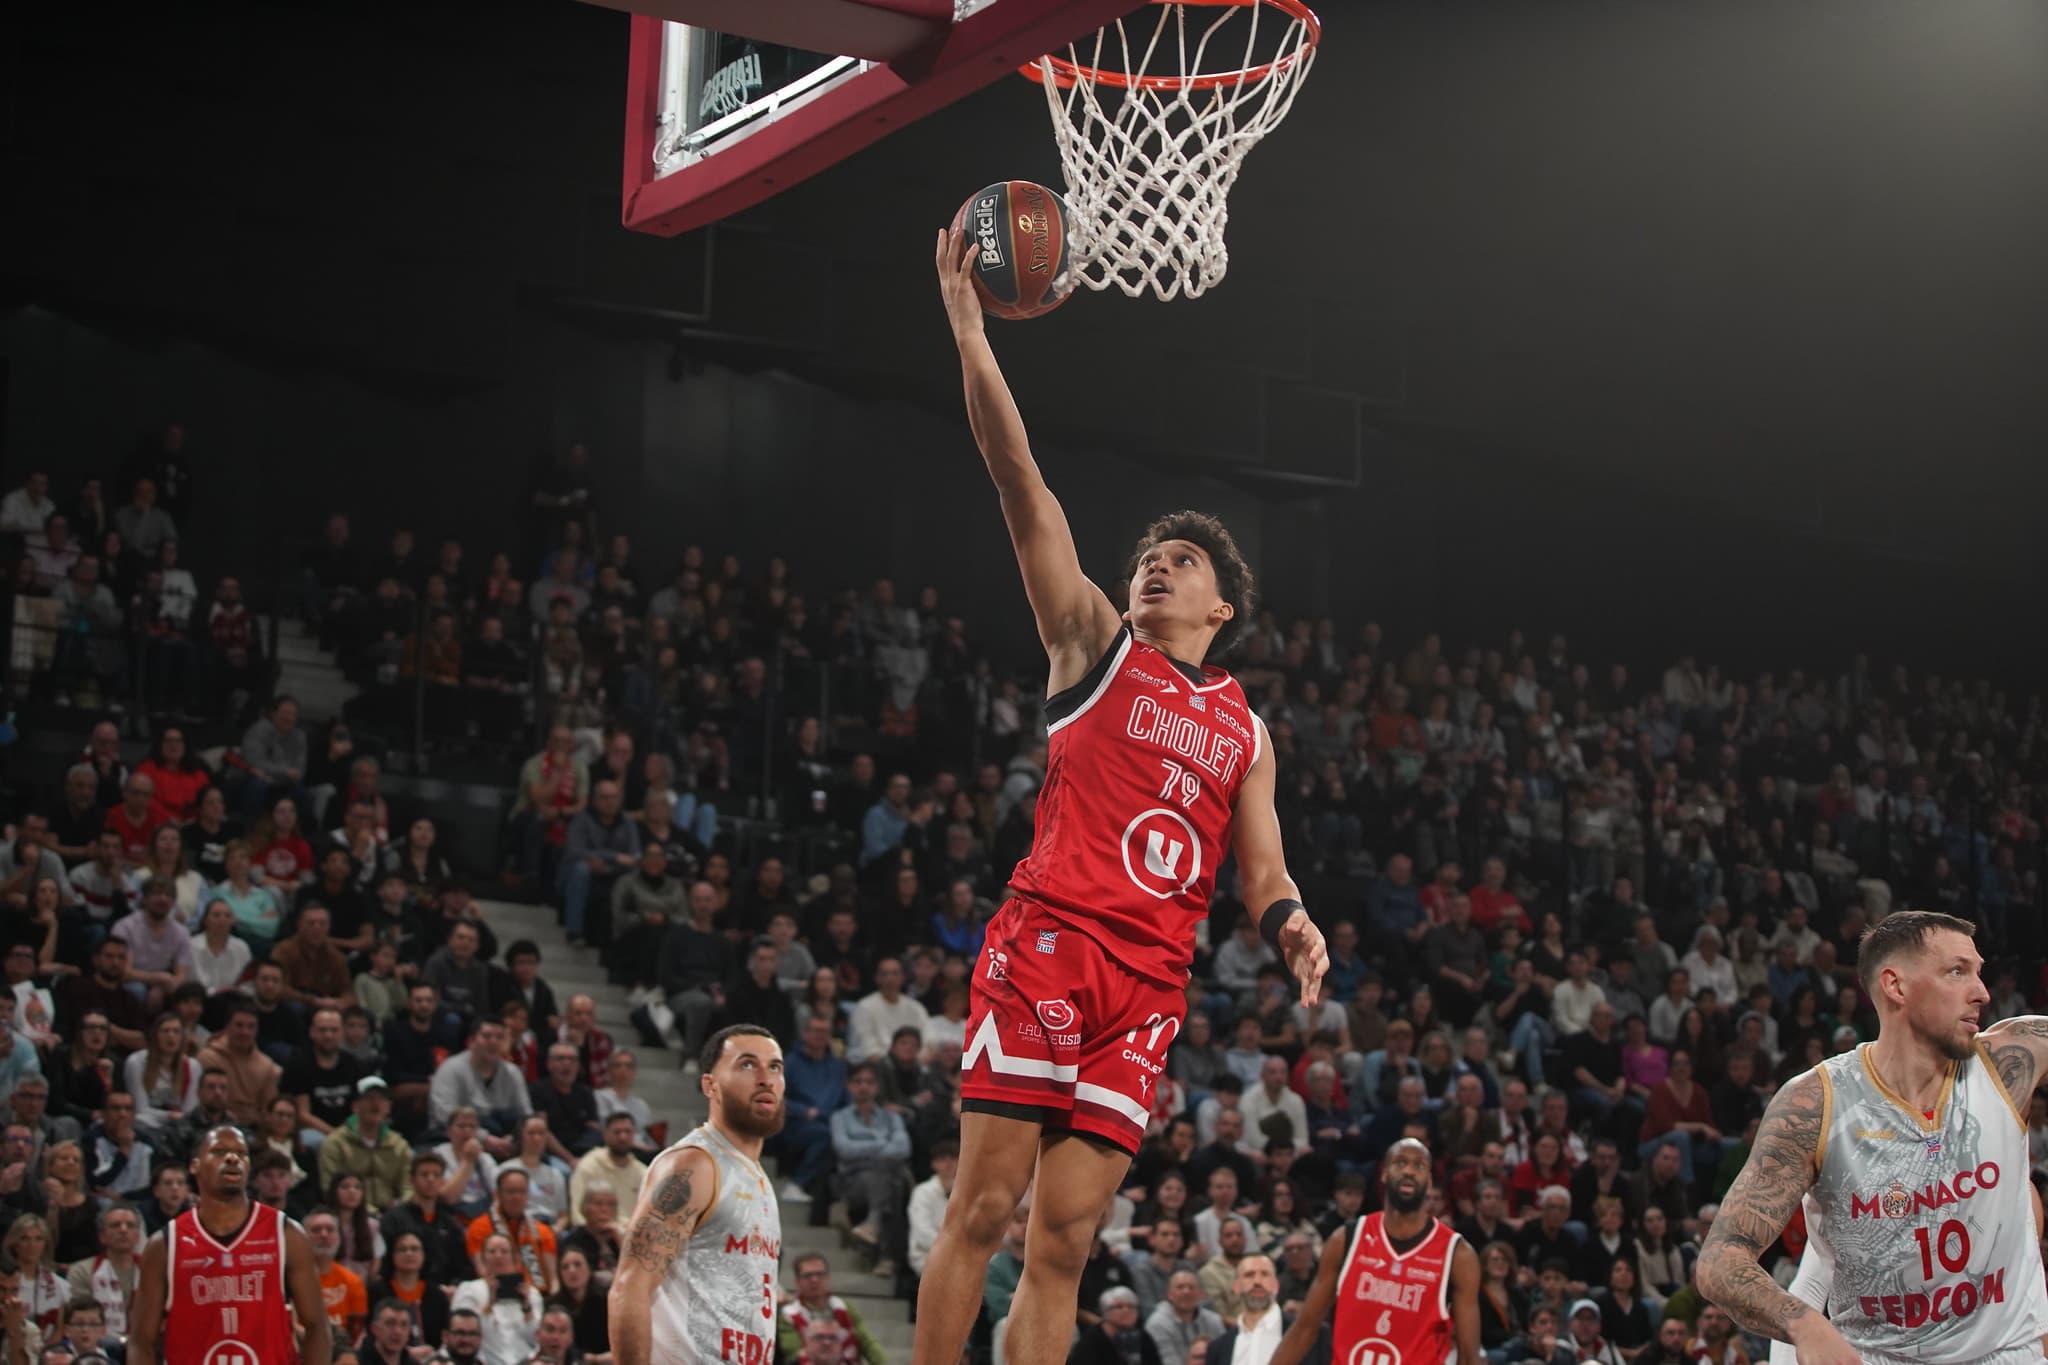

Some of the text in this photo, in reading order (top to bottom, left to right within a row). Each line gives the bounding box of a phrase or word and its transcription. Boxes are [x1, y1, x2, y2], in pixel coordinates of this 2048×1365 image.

[977, 198, 1001, 264] Betclic
[1127, 695, 1243, 786] CHOLET
[1159, 758, 1201, 809] 79
[1122, 1049, 1163, 1075] CHOLET
[1851, 1161, 2000, 1219] MONACO
[1914, 1219, 1971, 1281] 10
[190, 1270, 266, 1304] CHOLET
[1356, 1272, 1427, 1313] CHOLET
[1860, 1267, 2005, 1328] FEDCOM
[221, 1307, 239, 1334] 11
[1376, 1310, 1392, 1336] 6
